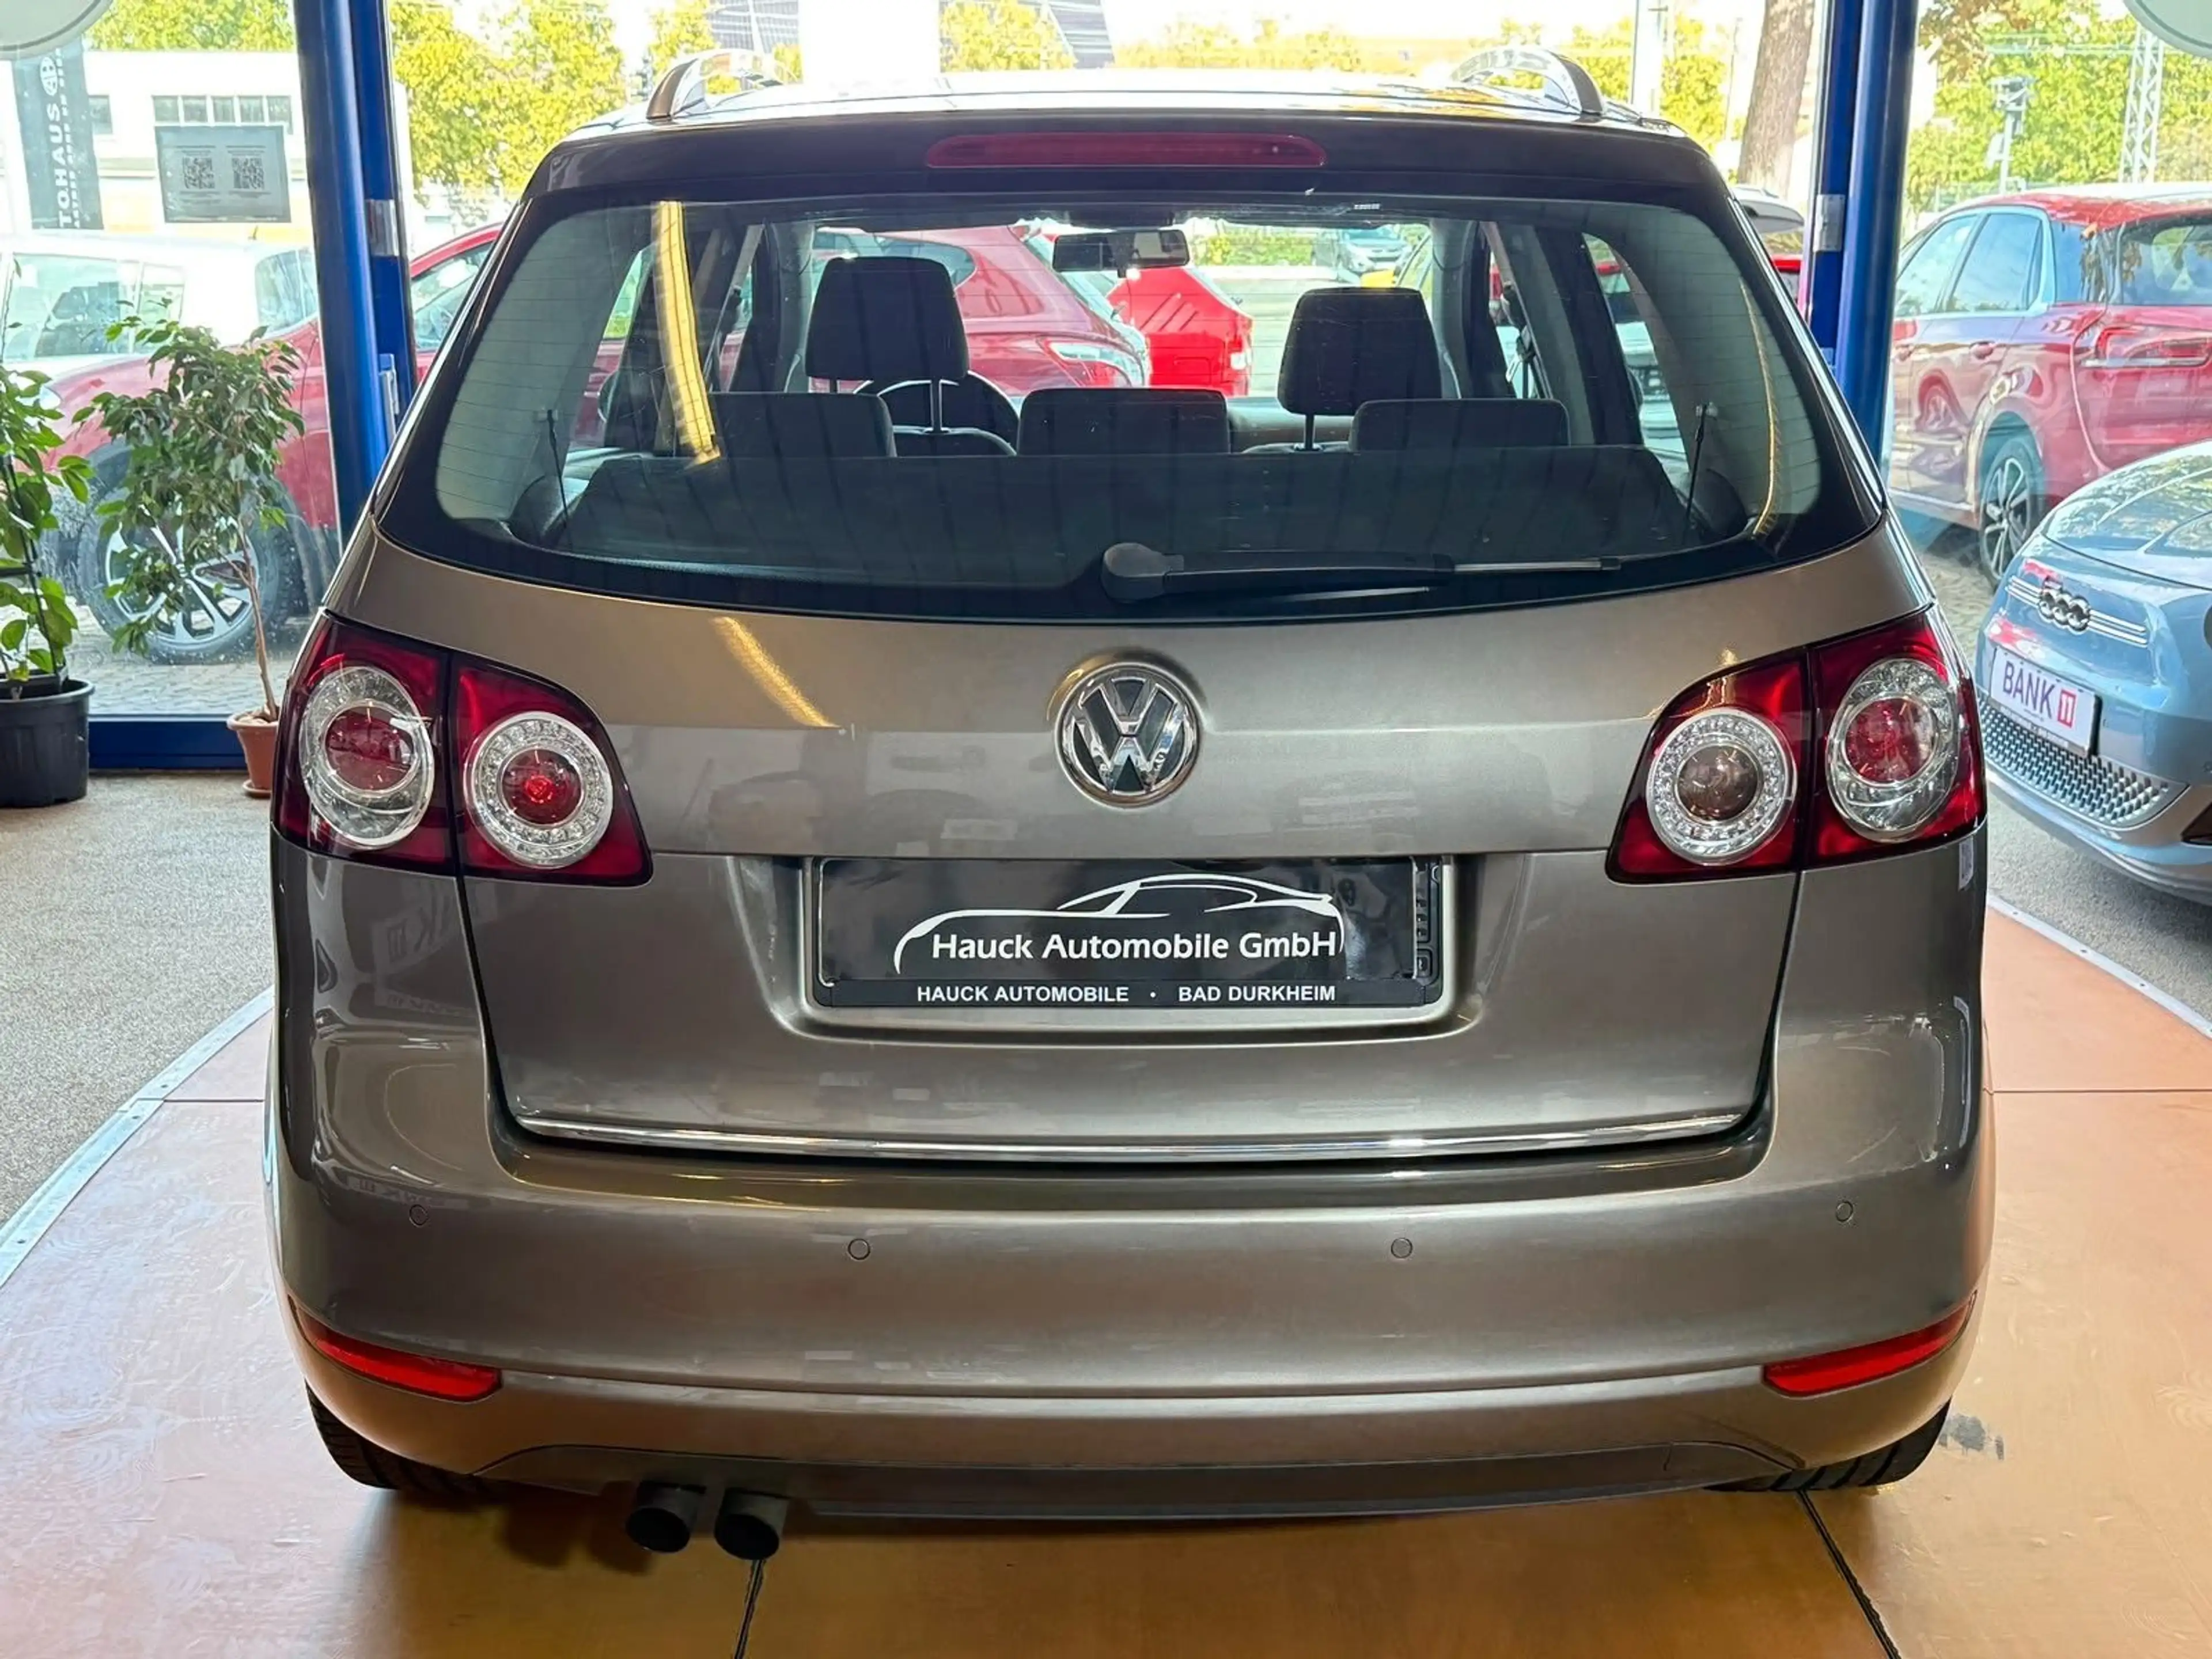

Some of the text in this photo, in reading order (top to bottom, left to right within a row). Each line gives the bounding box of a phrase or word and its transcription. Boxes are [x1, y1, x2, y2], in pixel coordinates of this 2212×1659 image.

[2002, 660, 2055, 719] BANK
[933, 931, 1336, 960] Hauck Automobile GmbH
[918, 985, 1336, 1002] HAUCK AUTOMOBILE BAD DURKHEIM
